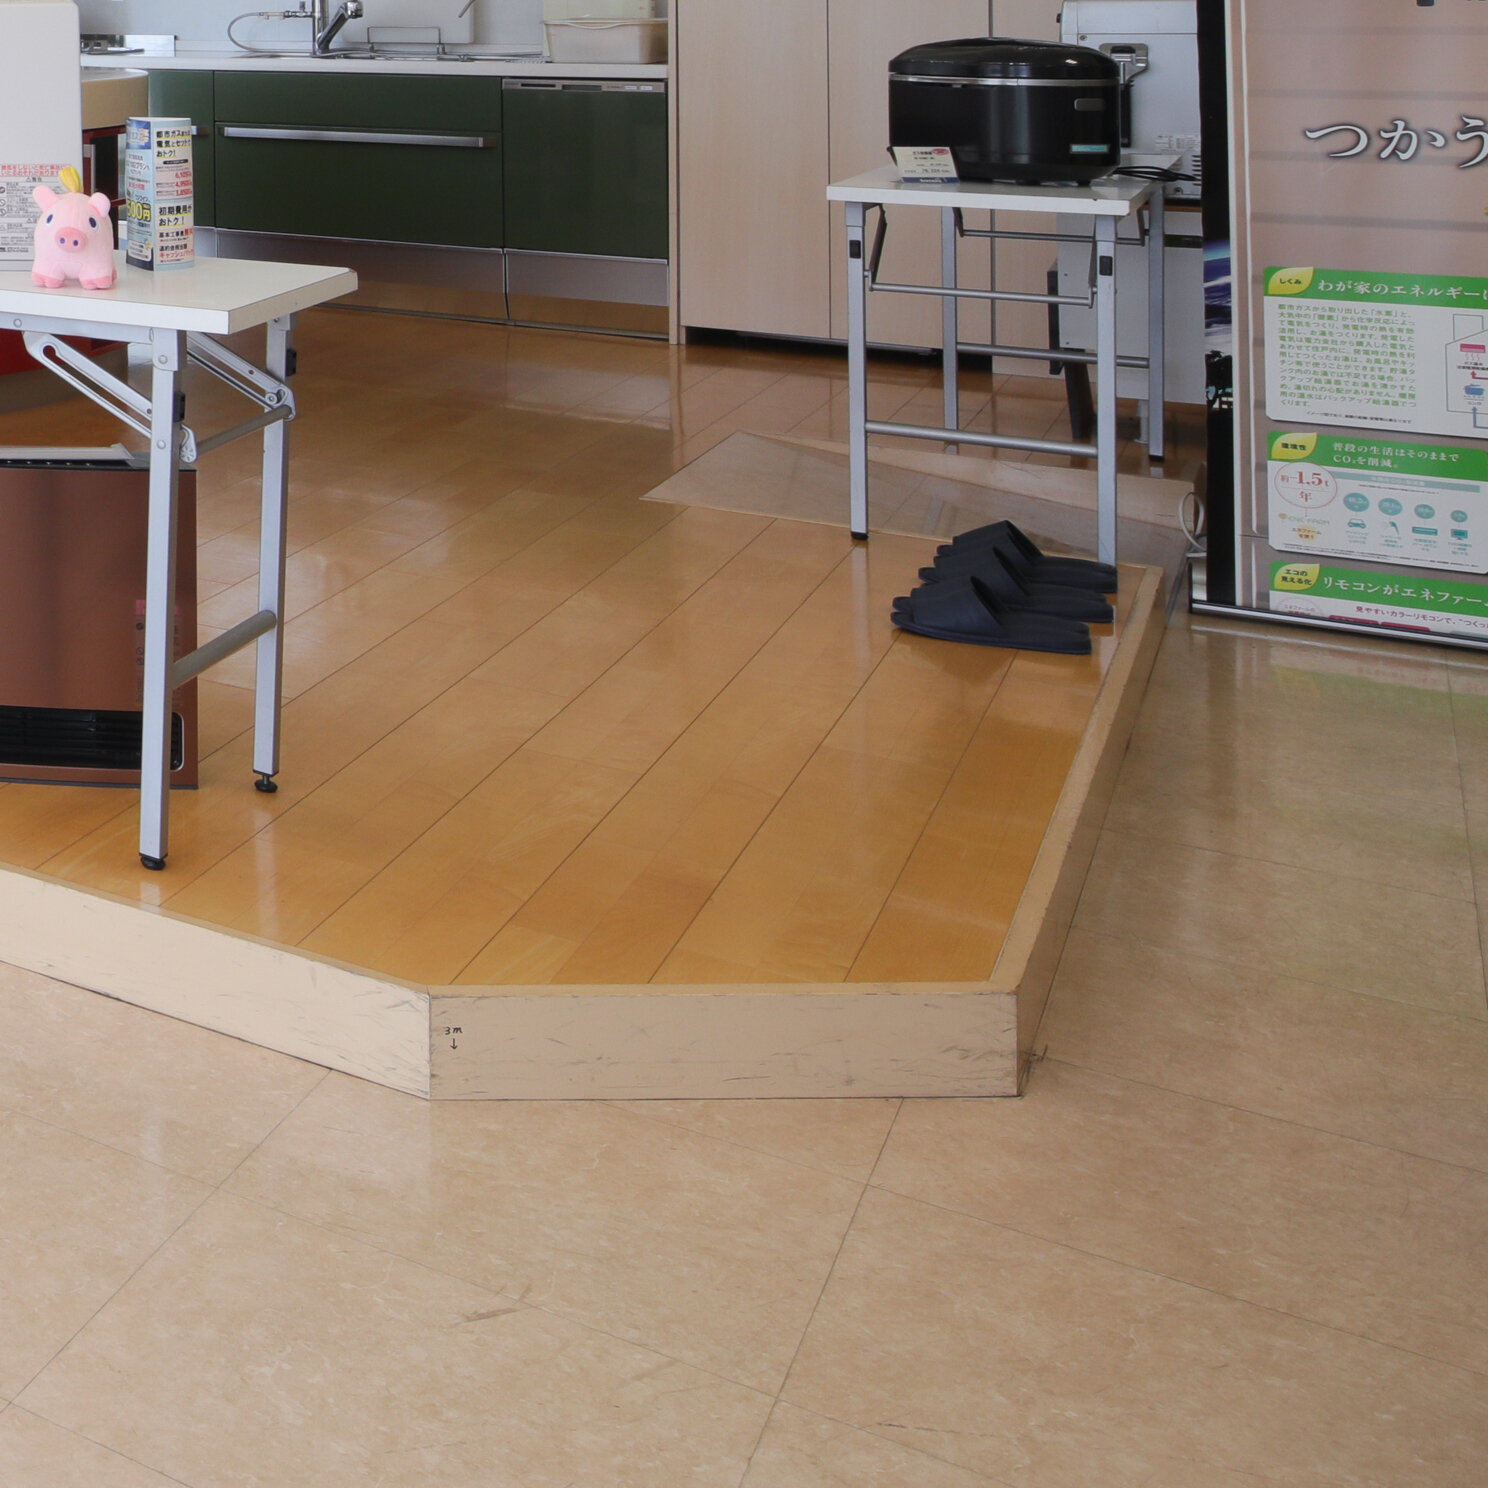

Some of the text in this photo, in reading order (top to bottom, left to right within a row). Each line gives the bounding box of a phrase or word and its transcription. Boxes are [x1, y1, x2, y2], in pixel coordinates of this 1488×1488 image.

[1333, 442, 1459, 462] 普段の生活はそのままで
[1298, 491, 1313, 502] 年
[1285, 568, 1308, 577] エコの
